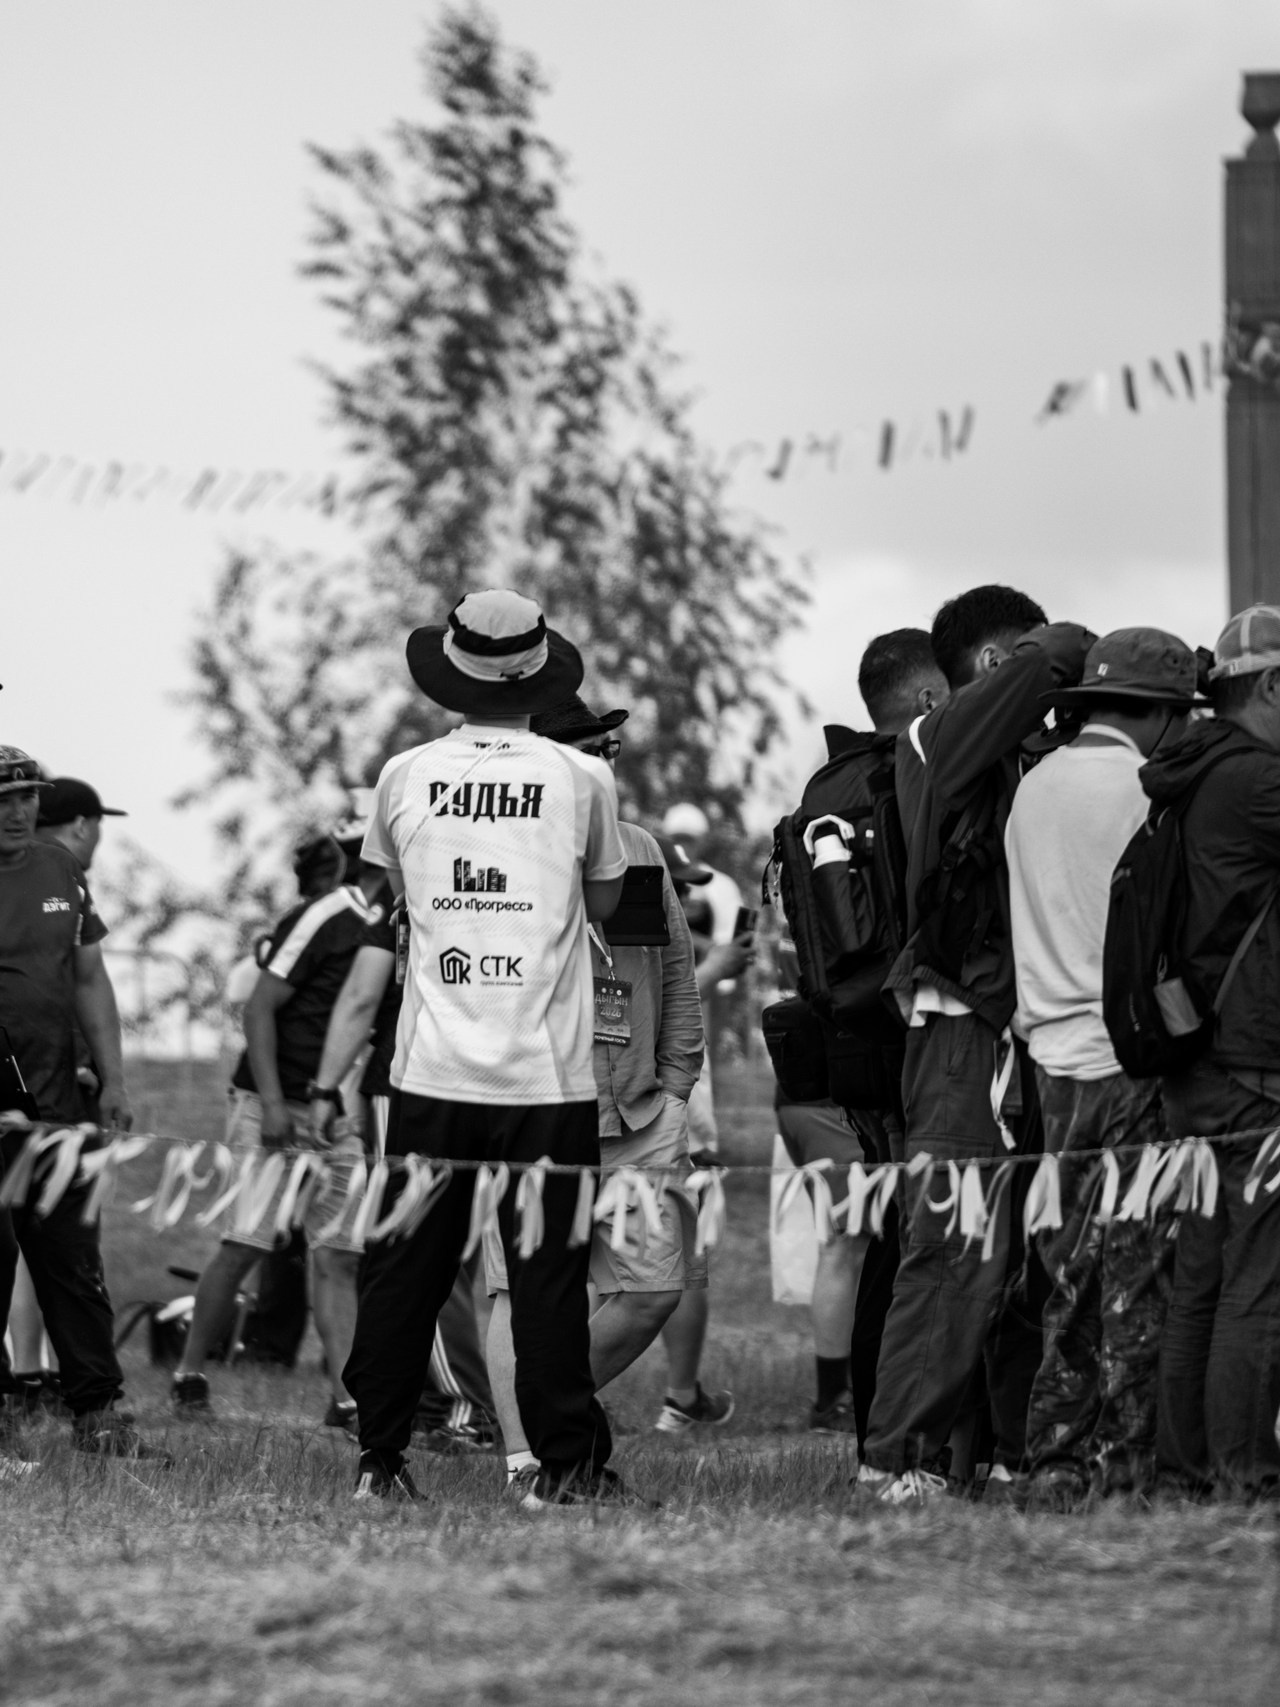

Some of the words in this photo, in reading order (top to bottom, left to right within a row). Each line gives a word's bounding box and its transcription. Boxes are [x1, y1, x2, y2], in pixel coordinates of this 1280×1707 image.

[432, 897, 462, 911] ООО
[464, 898, 534, 914] «Прогресс»
[480, 955, 523, 977] СТК
